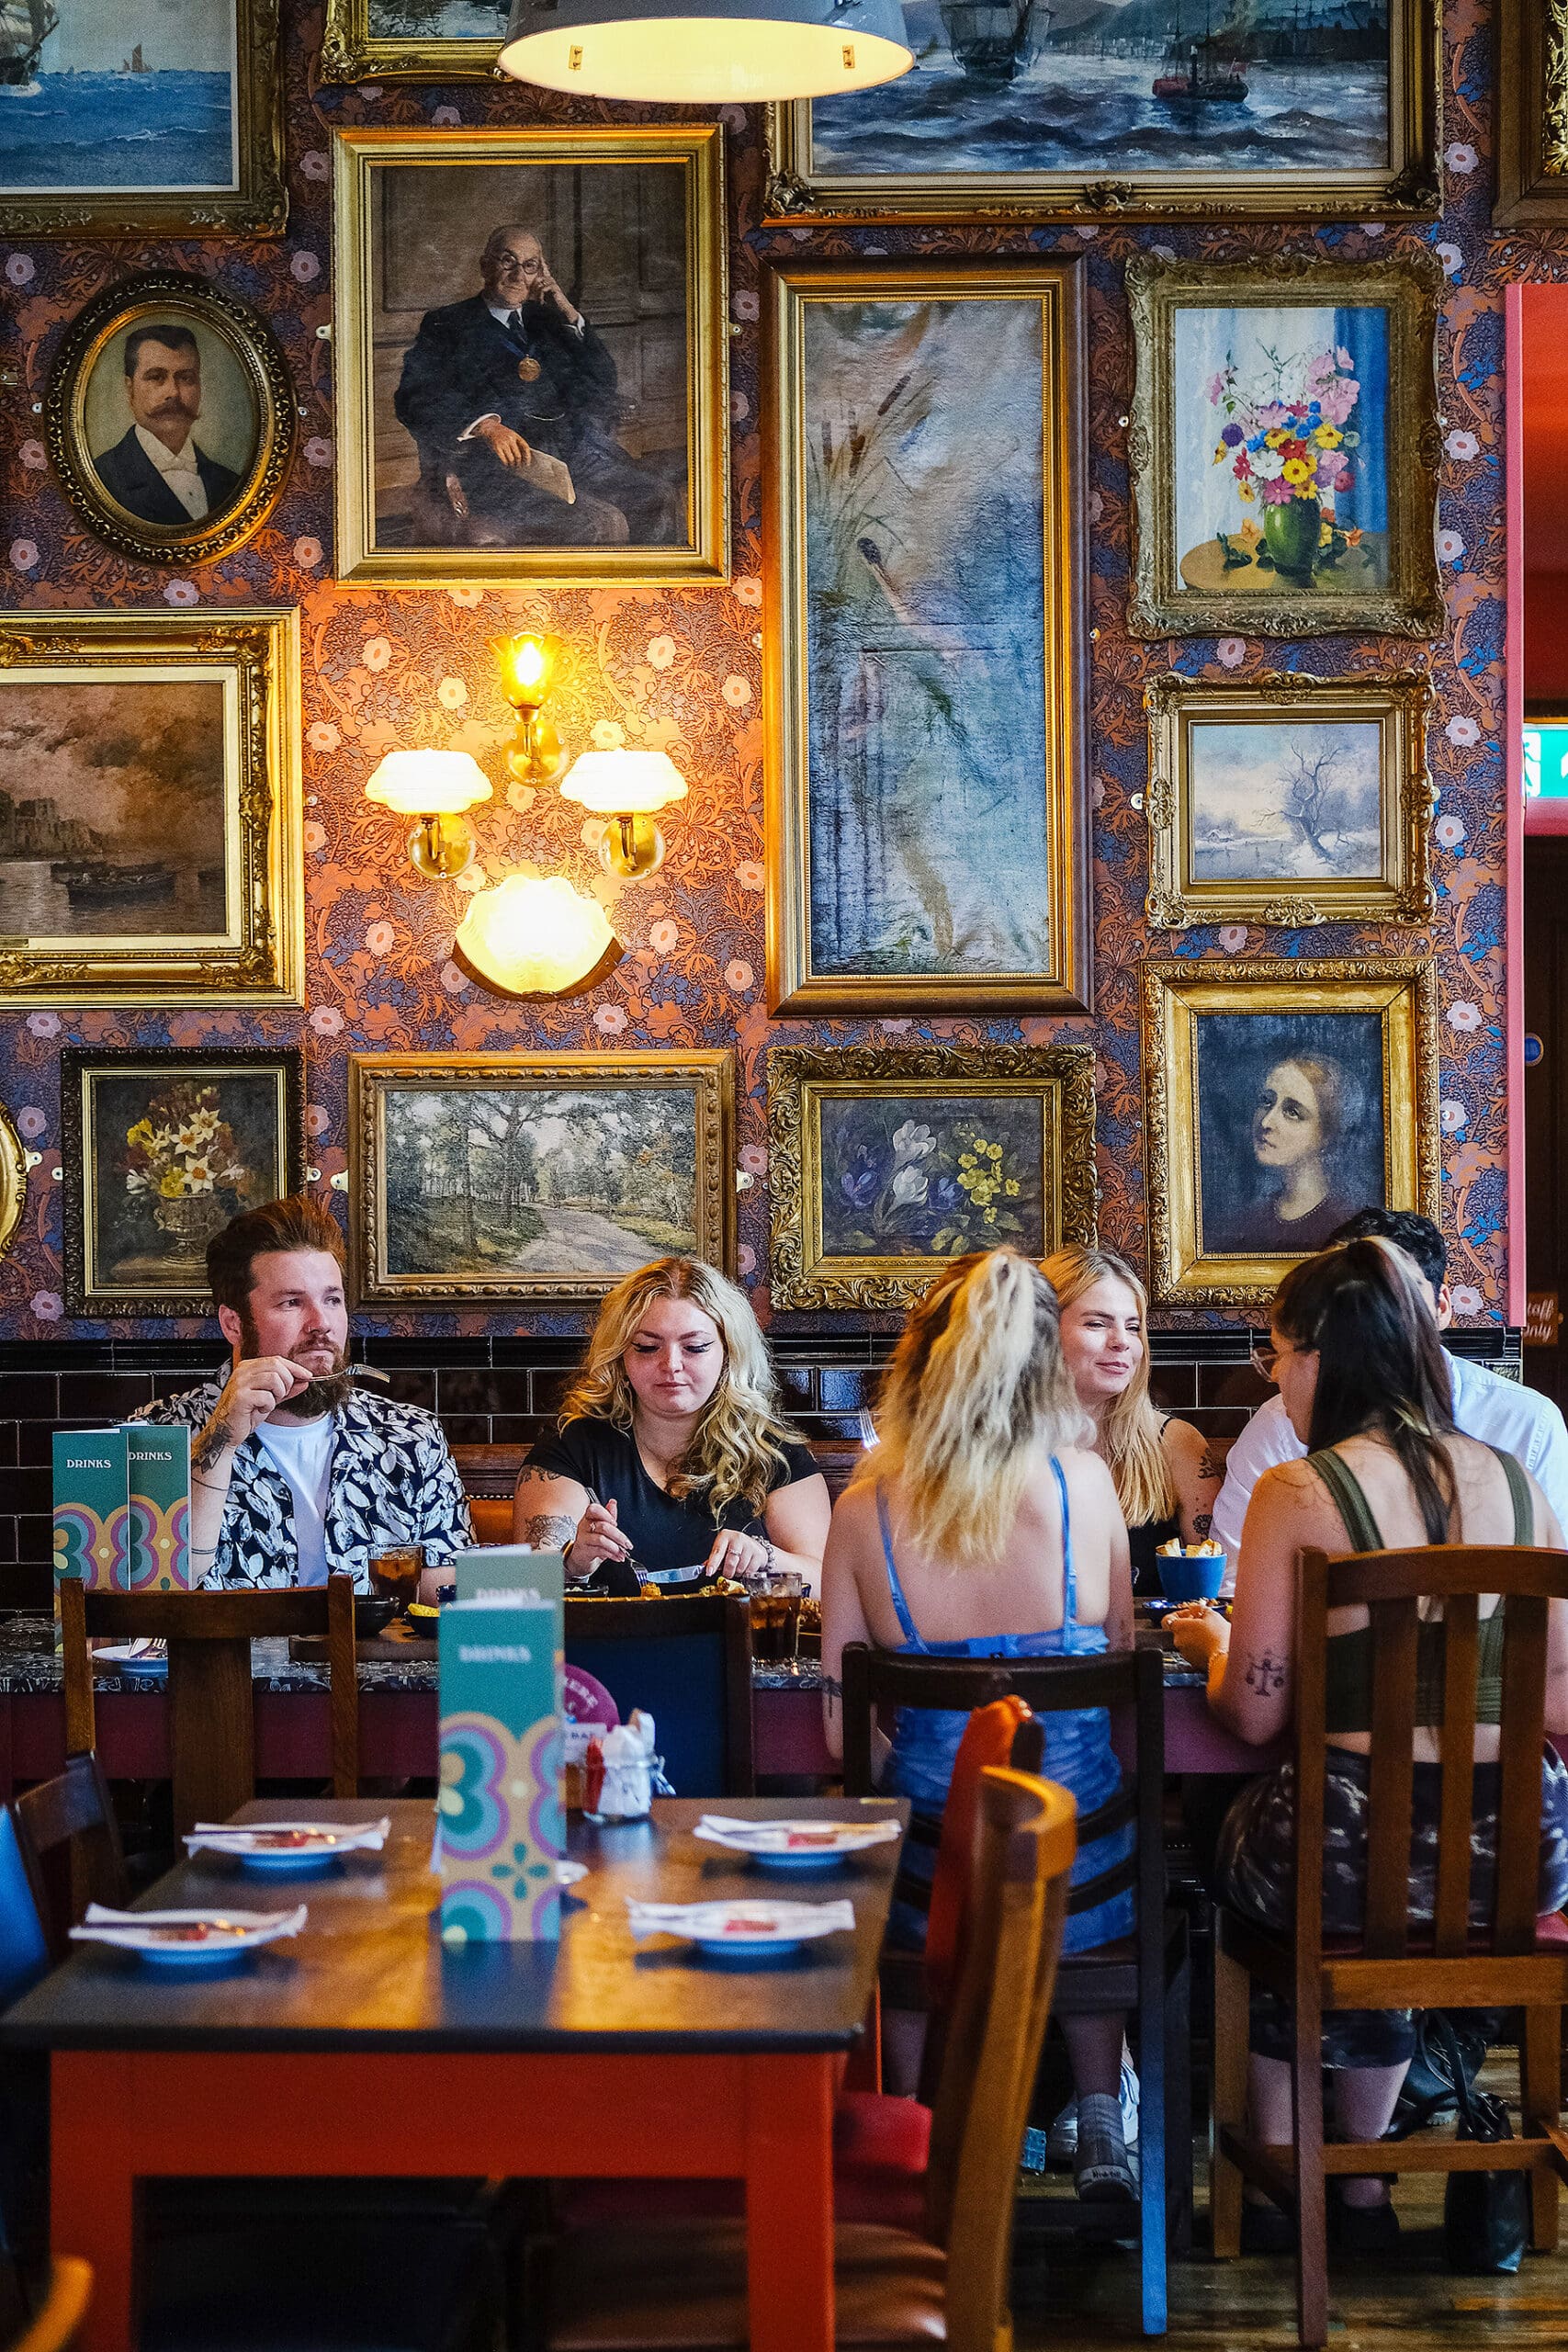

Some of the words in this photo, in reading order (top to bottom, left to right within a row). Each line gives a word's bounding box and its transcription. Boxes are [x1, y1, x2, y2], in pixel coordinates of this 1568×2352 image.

[1528, 1299, 1554, 1321] taff
[129, 1452, 173, 1461] DRINKS
[66, 1459, 112, 1468] DRINKS
[458, 1645, 532, 1662] DRINKS
